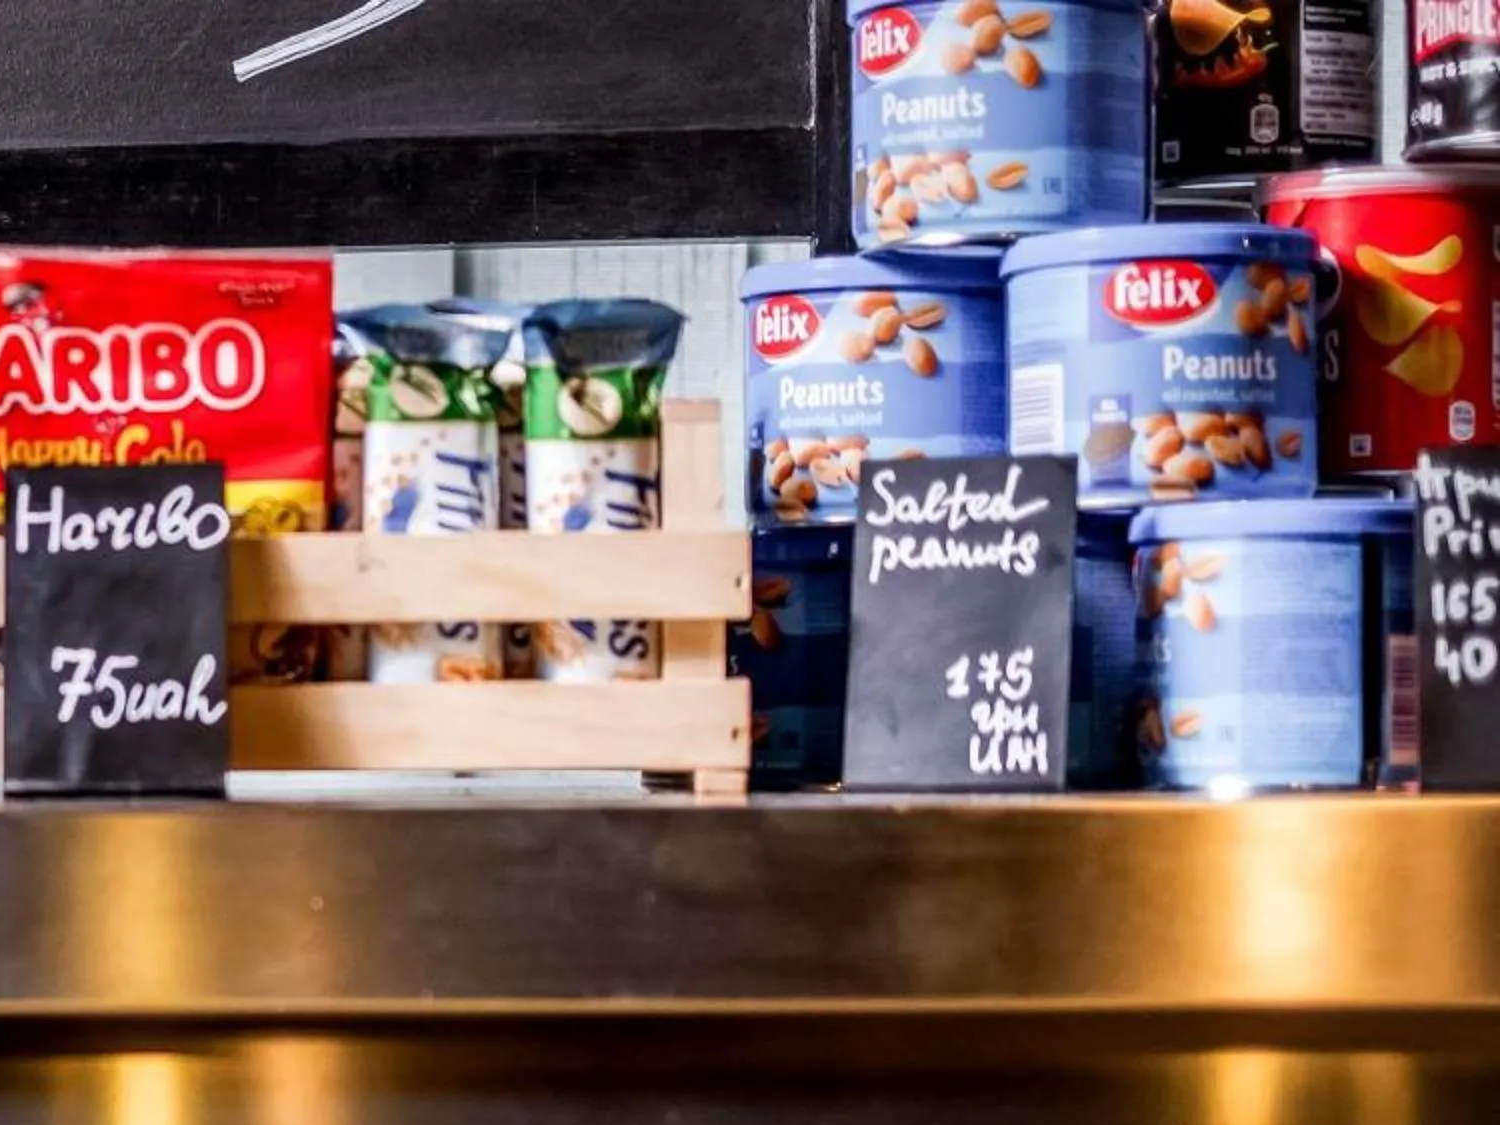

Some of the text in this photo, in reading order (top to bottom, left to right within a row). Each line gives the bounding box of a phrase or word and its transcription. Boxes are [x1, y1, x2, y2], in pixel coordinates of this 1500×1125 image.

[881, 87, 986, 127] Peanuts
[1113, 266, 1203, 311] felix
[1163, 346, 1277, 383] Peanuts
[780, 373, 885, 410] Peanuts
[15, 483, 230, 553] Haribo
[866, 464, 1050, 531] Salted
[868, 529, 1040, 584] peanuts
